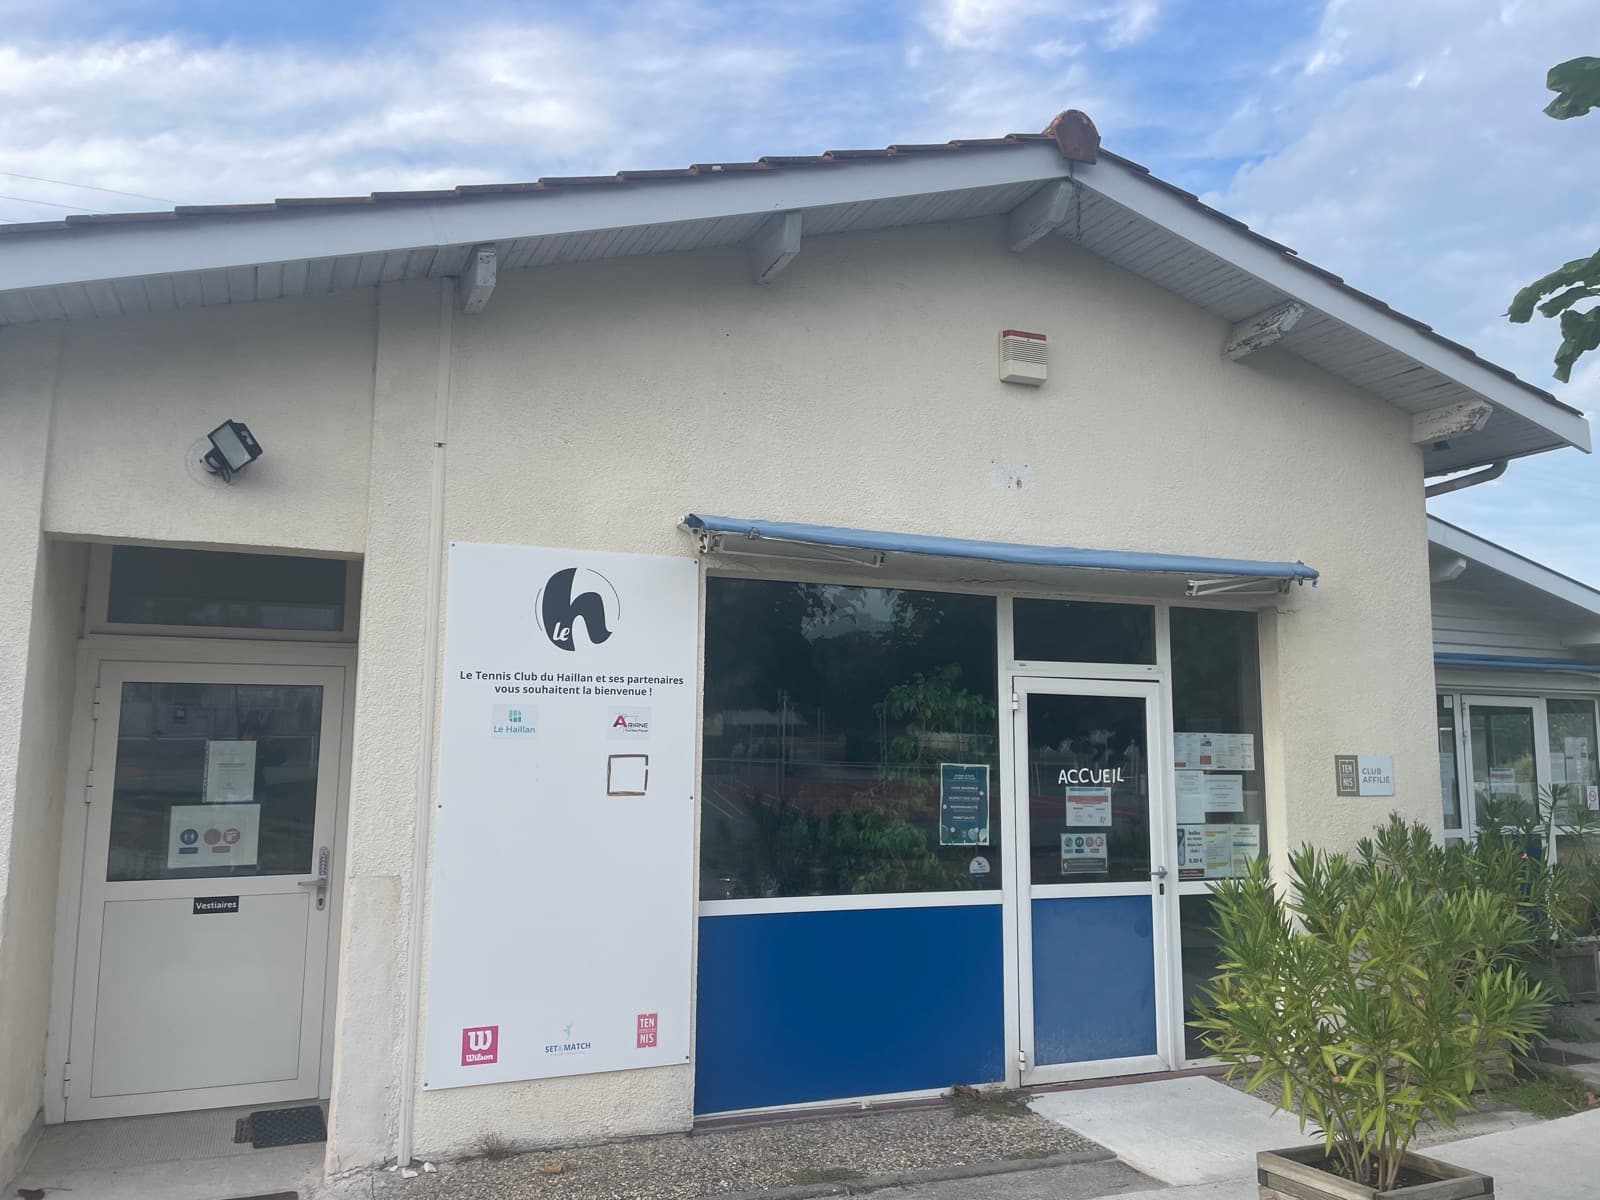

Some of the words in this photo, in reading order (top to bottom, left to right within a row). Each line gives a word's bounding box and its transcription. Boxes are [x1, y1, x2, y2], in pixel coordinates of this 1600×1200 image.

[552, 621, 570, 642] le
[459, 670, 473, 681] Le
[475, 671, 511, 682] Tennis
[513, 671, 538, 682] Club
[540, 672, 554, 683] du
[556, 673, 593, 684] Haillan
[595, 674, 607, 684] et
[608, 676, 625, 685] ses
[626, 674, 684, 687] partenaires
[494, 685, 520, 695] vous
[522, 685, 580, 696] souhaitent
[582, 685, 592, 695] la
[594, 686, 647, 697] bienvenue
[493, 725, 504, 734] Le
[505, 724, 536, 735] Haillan
[1057, 767, 1125, 785] ACCUEIL
[1361, 767, 1382, 775] CLUB
[195, 900, 237, 911] Vestiaires
[639, 1017, 655, 1028] TEN
[467, 1030, 492, 1051] W
[639, 1033, 655, 1044] NIS
[465, 1053, 494, 1063] Wilson
